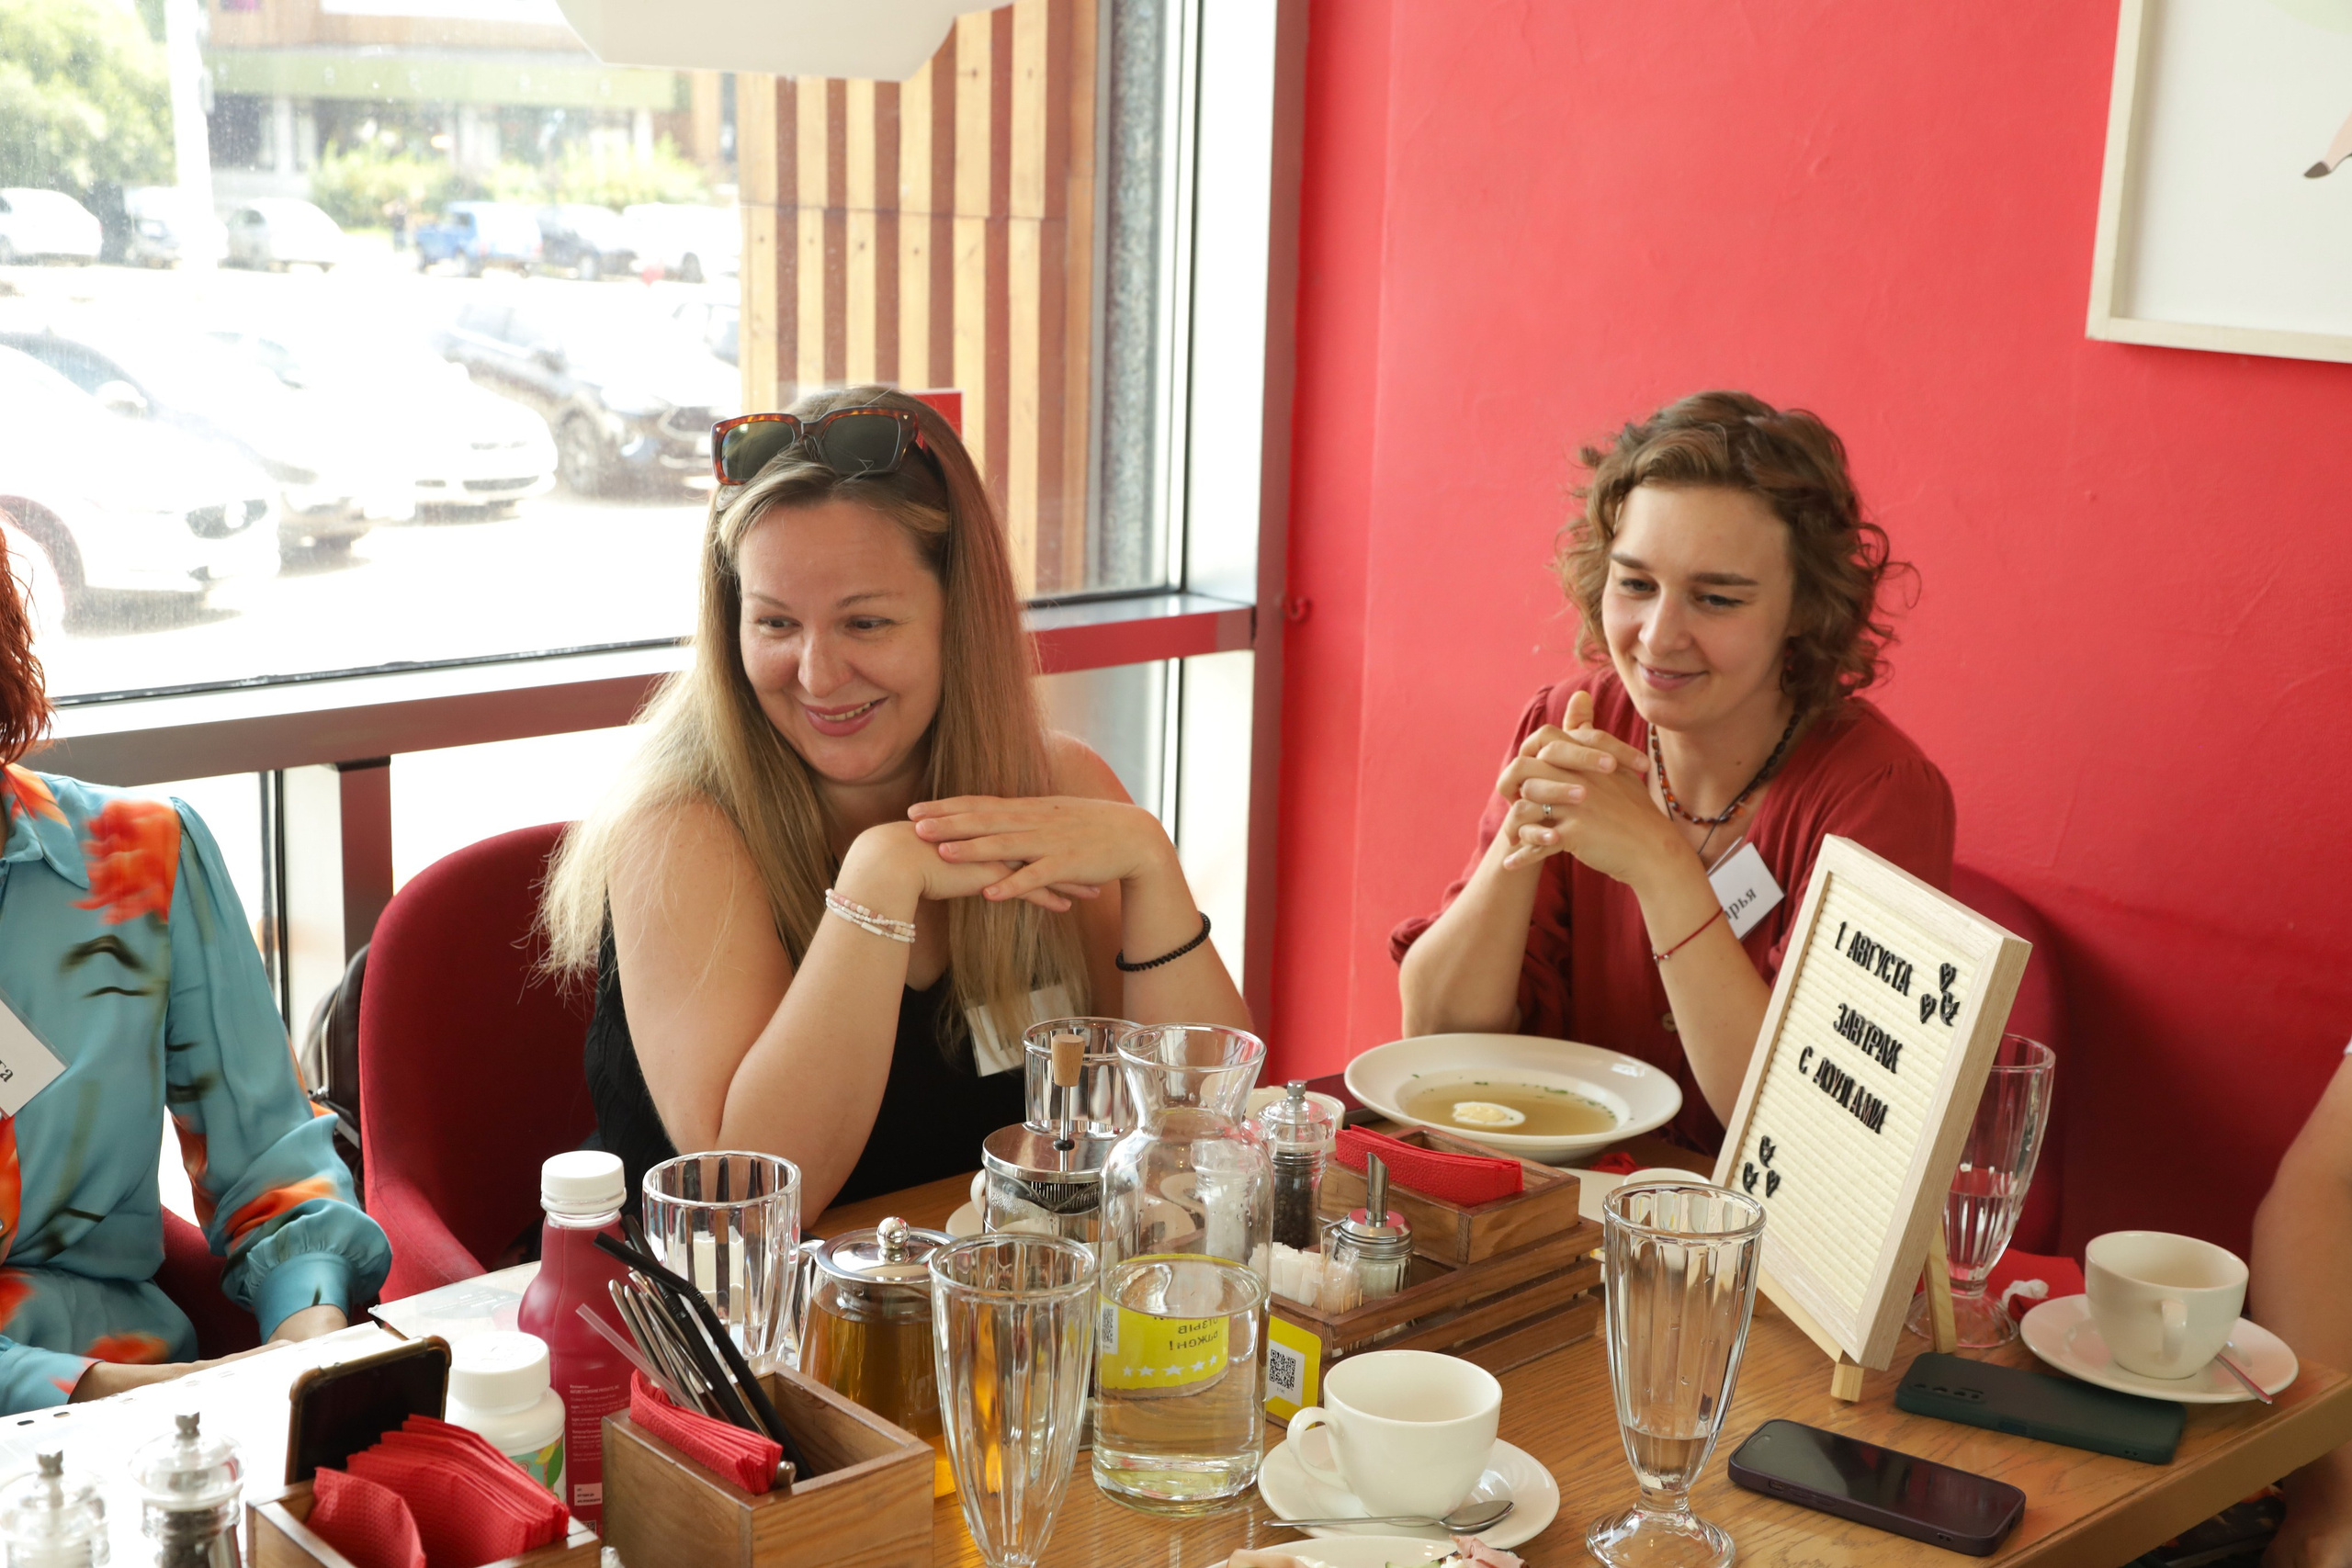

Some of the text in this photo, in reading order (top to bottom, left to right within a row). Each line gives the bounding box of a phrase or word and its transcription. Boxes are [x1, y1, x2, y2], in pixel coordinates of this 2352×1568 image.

[1835, 921, 1913, 997] 1 АВГУСТА
[1833, 1002, 1903, 1074] ЗАВТРАК
[1799, 1045, 1888, 1134] С ДОУЛАМИ
